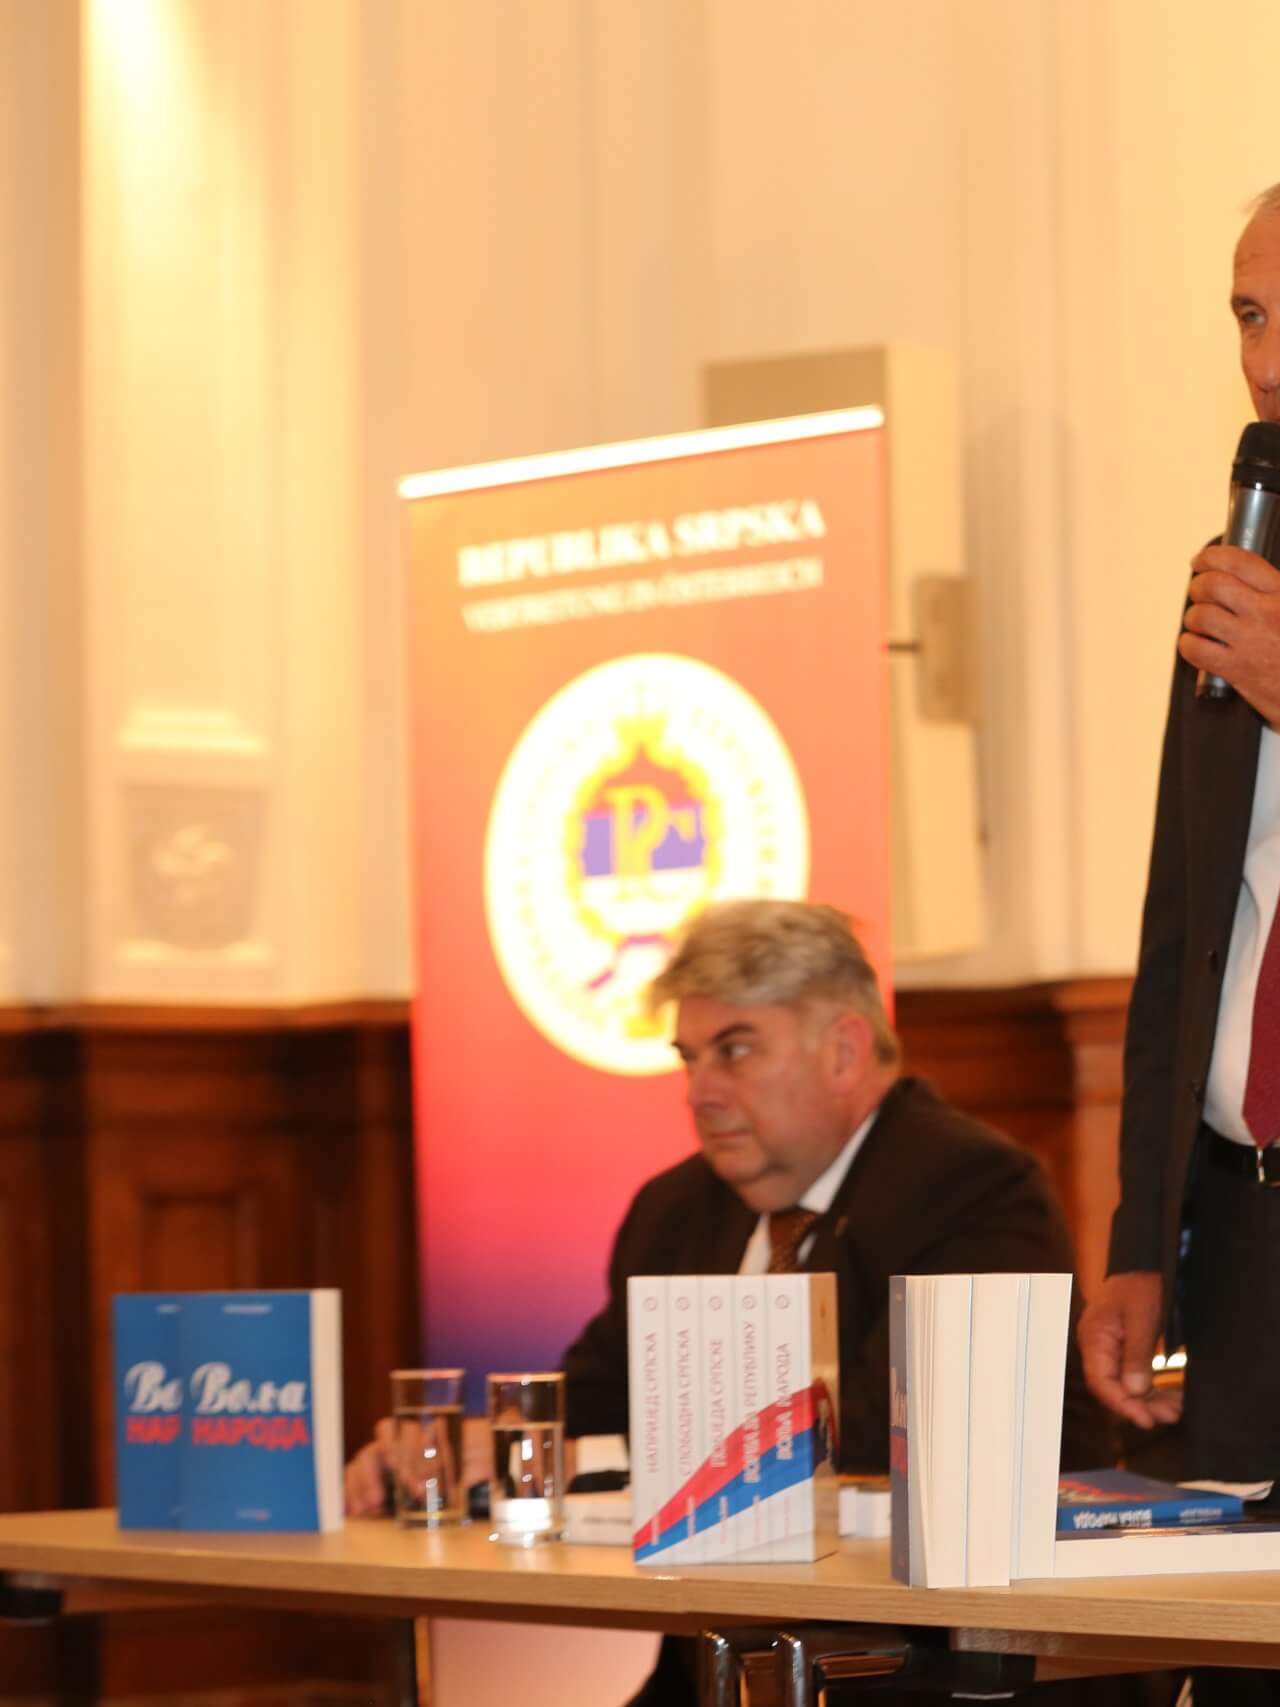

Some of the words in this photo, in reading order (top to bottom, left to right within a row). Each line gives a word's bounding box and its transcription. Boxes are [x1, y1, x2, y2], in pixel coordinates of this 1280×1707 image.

[673, 496, 827, 557] SRPSKA
[643, 1332, 658, 1393] СРПСКА
[676, 1328, 691, 1390] СРПСКА
[709, 1338, 724, 1395] СРПСКЕ
[774, 1342, 793, 1408] НАРОДА
[192, 1415, 309, 1451] НАРОДА
